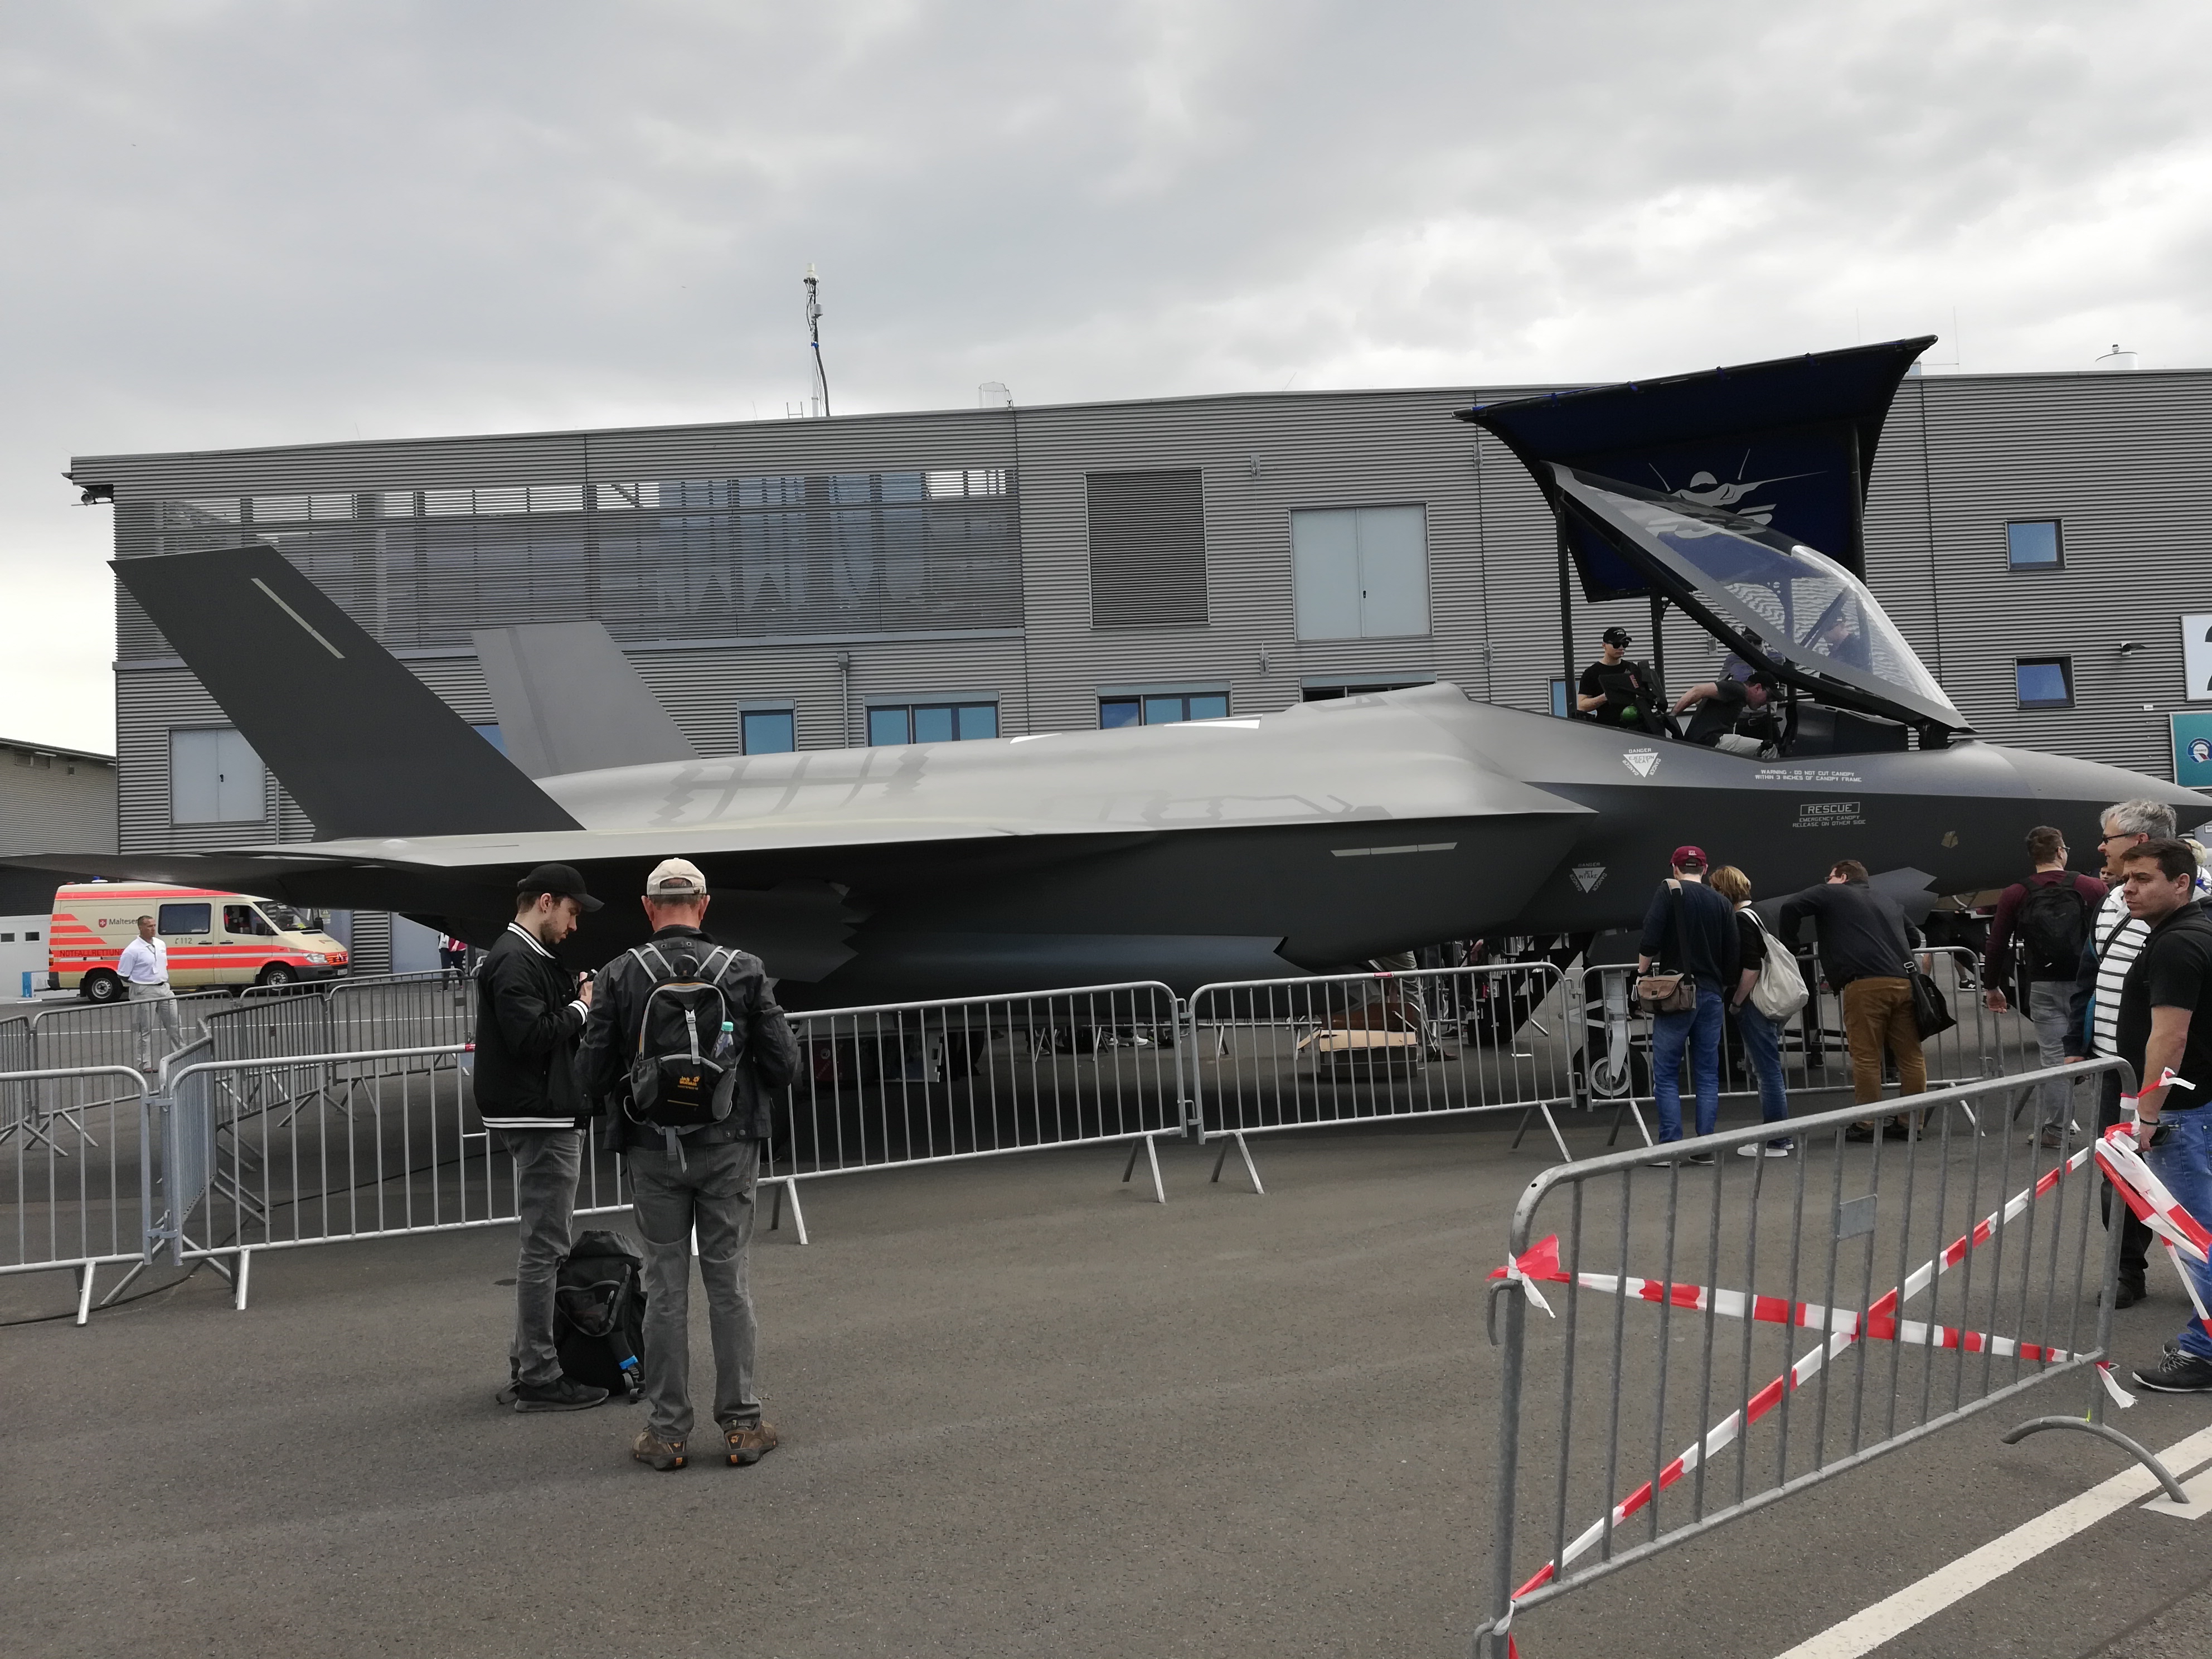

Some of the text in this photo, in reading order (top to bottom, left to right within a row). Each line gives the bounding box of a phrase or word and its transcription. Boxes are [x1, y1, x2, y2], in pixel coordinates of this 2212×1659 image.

[1622, 759, 1639, 775] DANGER
[1649, 758, 1661, 775] DANGER
[1808, 804, 1852, 814] RESCUE
